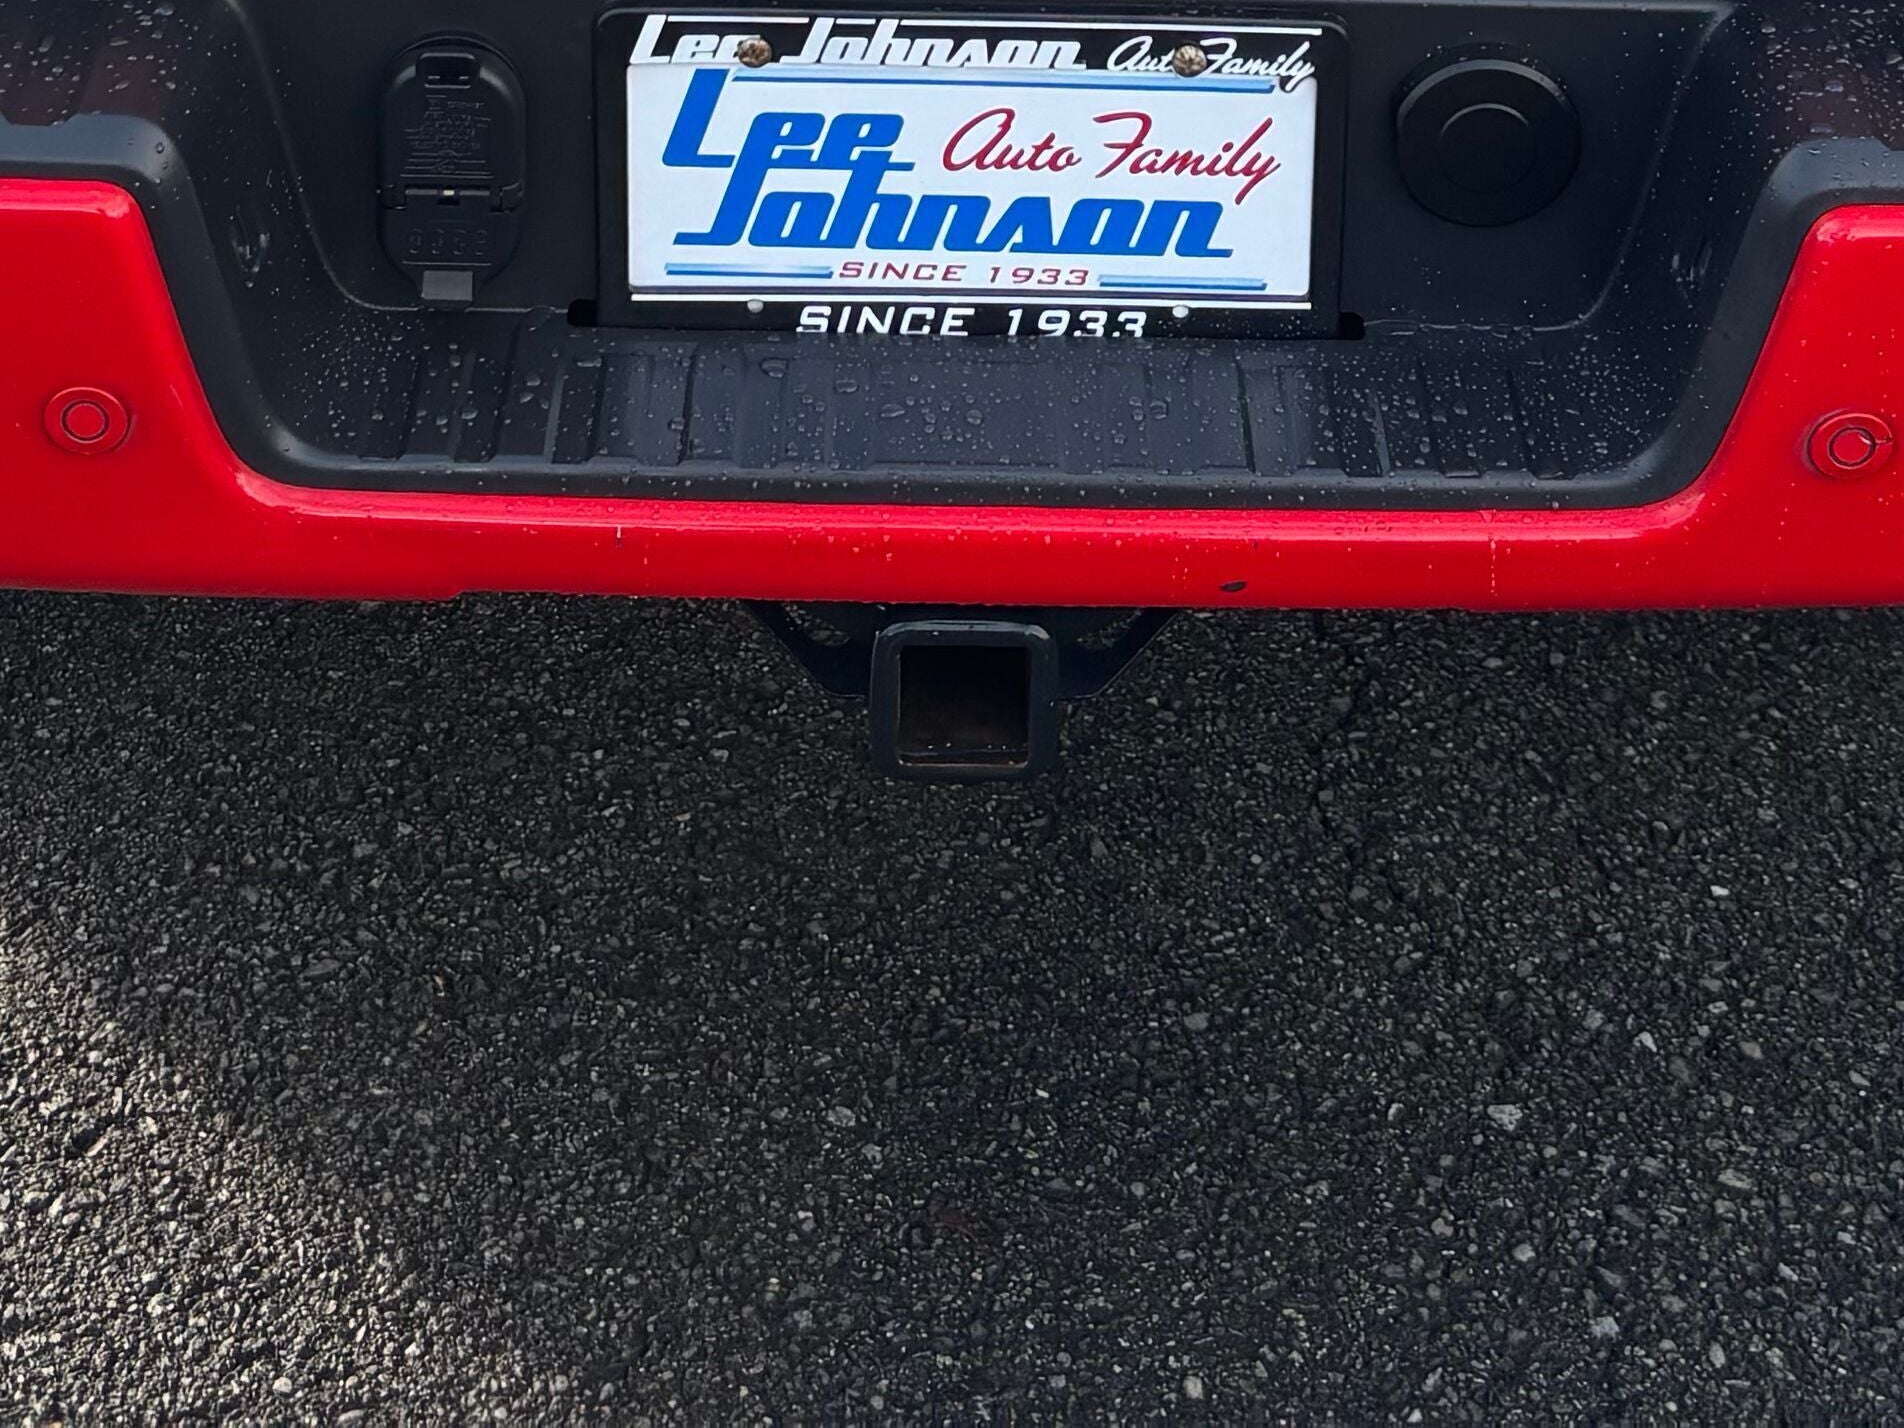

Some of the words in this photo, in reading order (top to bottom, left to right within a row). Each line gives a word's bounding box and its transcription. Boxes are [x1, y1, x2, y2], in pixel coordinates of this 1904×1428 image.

[779, 16, 1088, 71] Johnson
[1107, 35, 1182, 74] Aut
[1195, 37, 1316, 92] Family
[661, 68, 916, 173] Lee
[941, 106, 1082, 175] Auto
[1093, 110, 1282, 206] Family
[672, 164, 1234, 259] Johnson
[839, 260, 967, 283] SINCE
[989, 265, 1090, 287] 1933
[795, 304, 976, 337] SINCE
[1007, 308, 1147, 339] 1933
